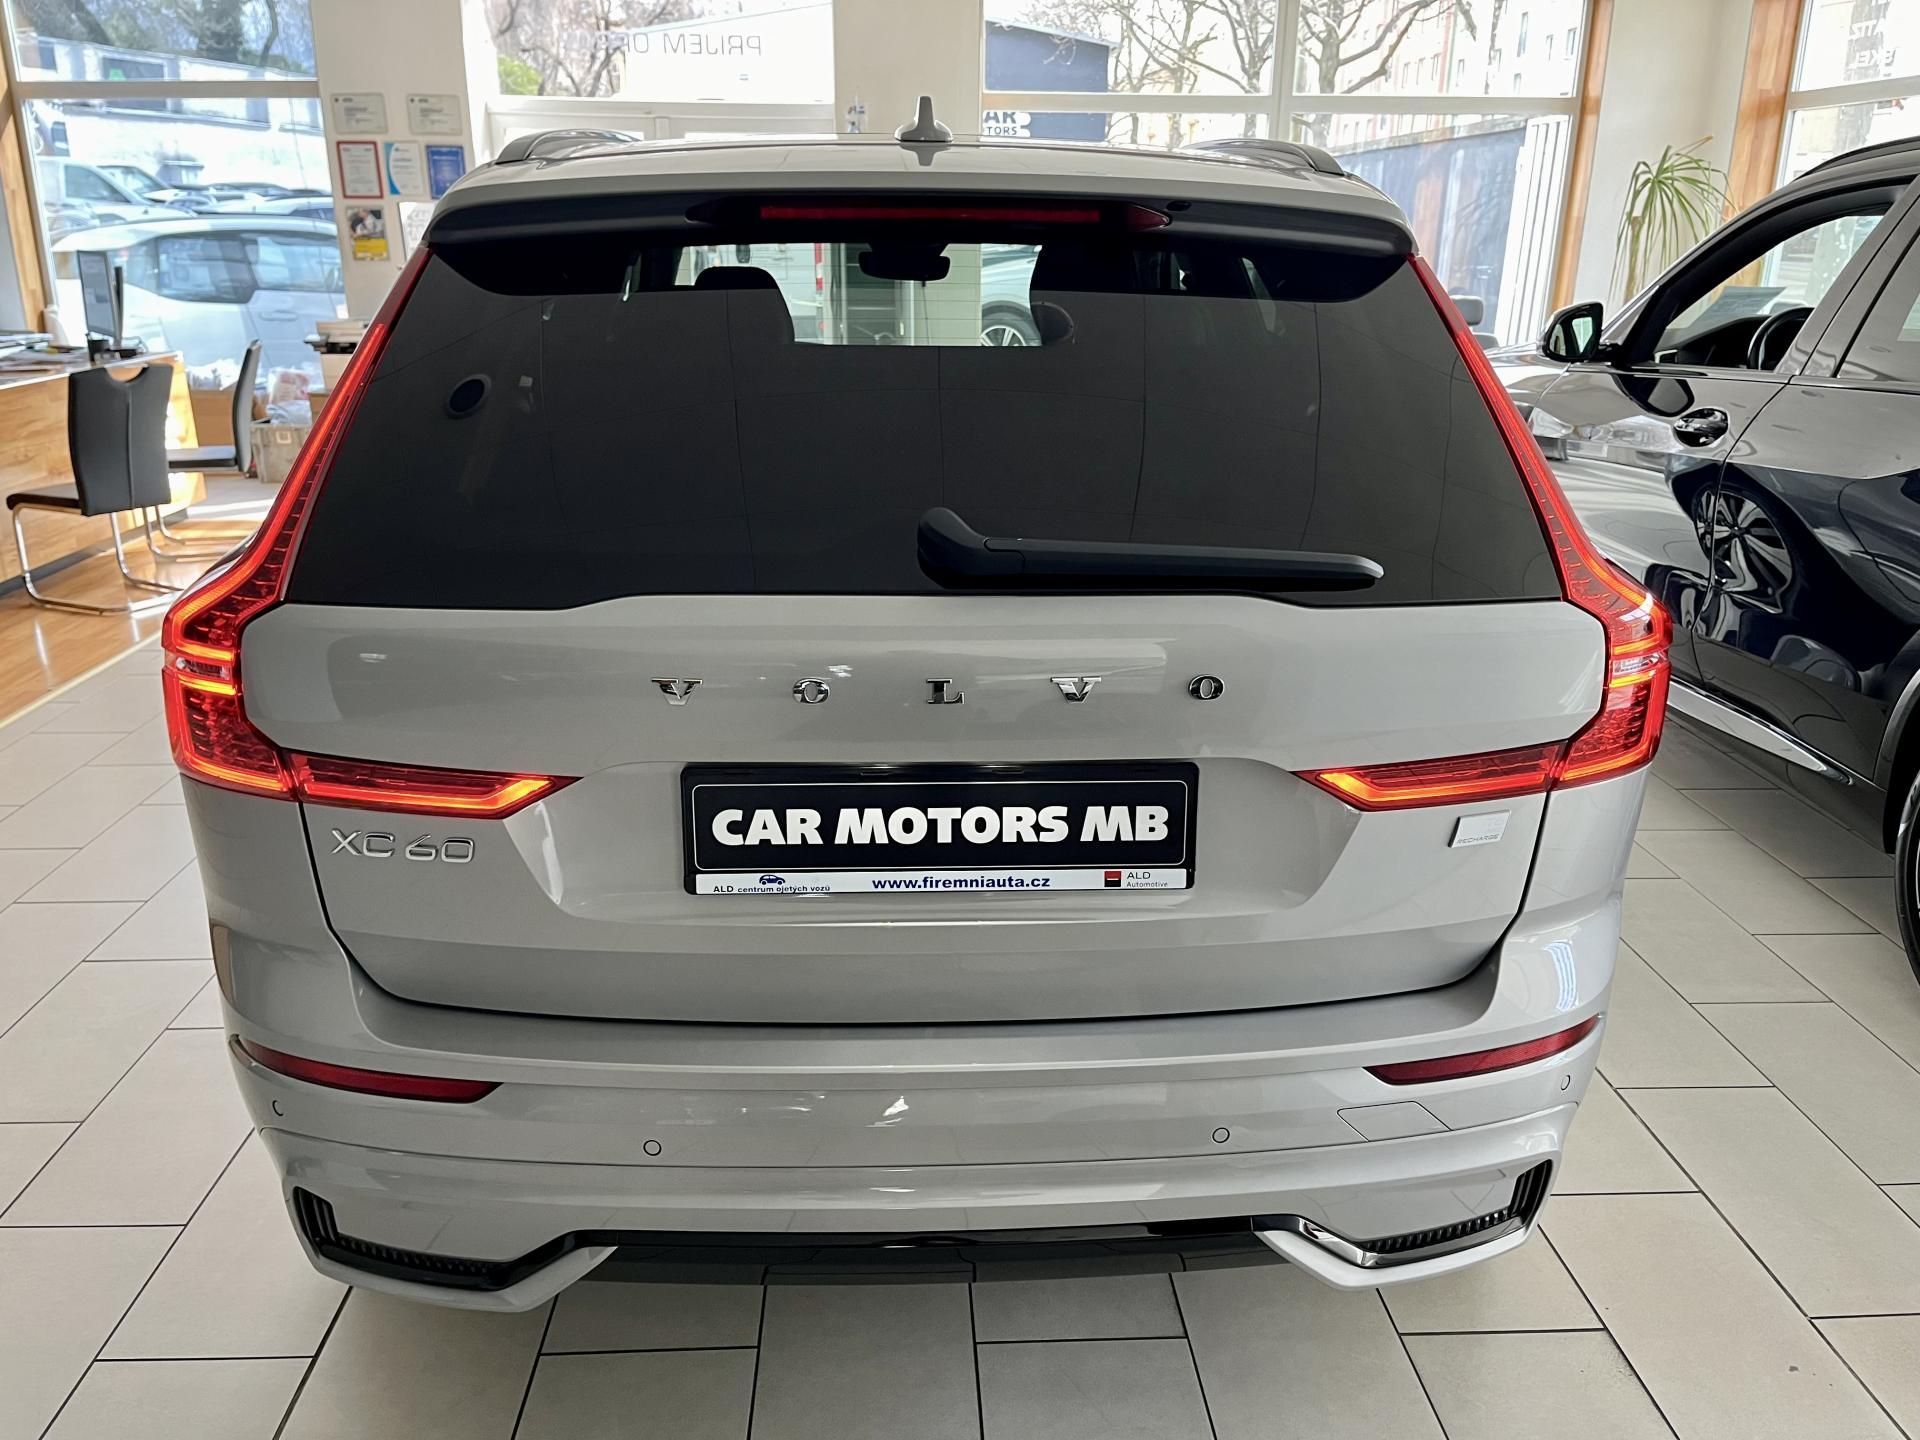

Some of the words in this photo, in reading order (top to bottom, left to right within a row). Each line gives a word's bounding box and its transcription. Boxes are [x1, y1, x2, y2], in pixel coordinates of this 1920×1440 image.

[651, 674, 1225, 705] VOLVO
[711, 808, 824, 846] CAR
[834, 805, 1069, 845] MOTORS
[1079, 805, 1169, 842] MB
[1126, 871, 1151, 880] ALD
[872, 876, 1050, 889] www.firemniauta.cz
[1126, 880, 1168, 888] Automotive
[713, 885, 734, 893] ALD
[737, 885, 774, 893] centrum
